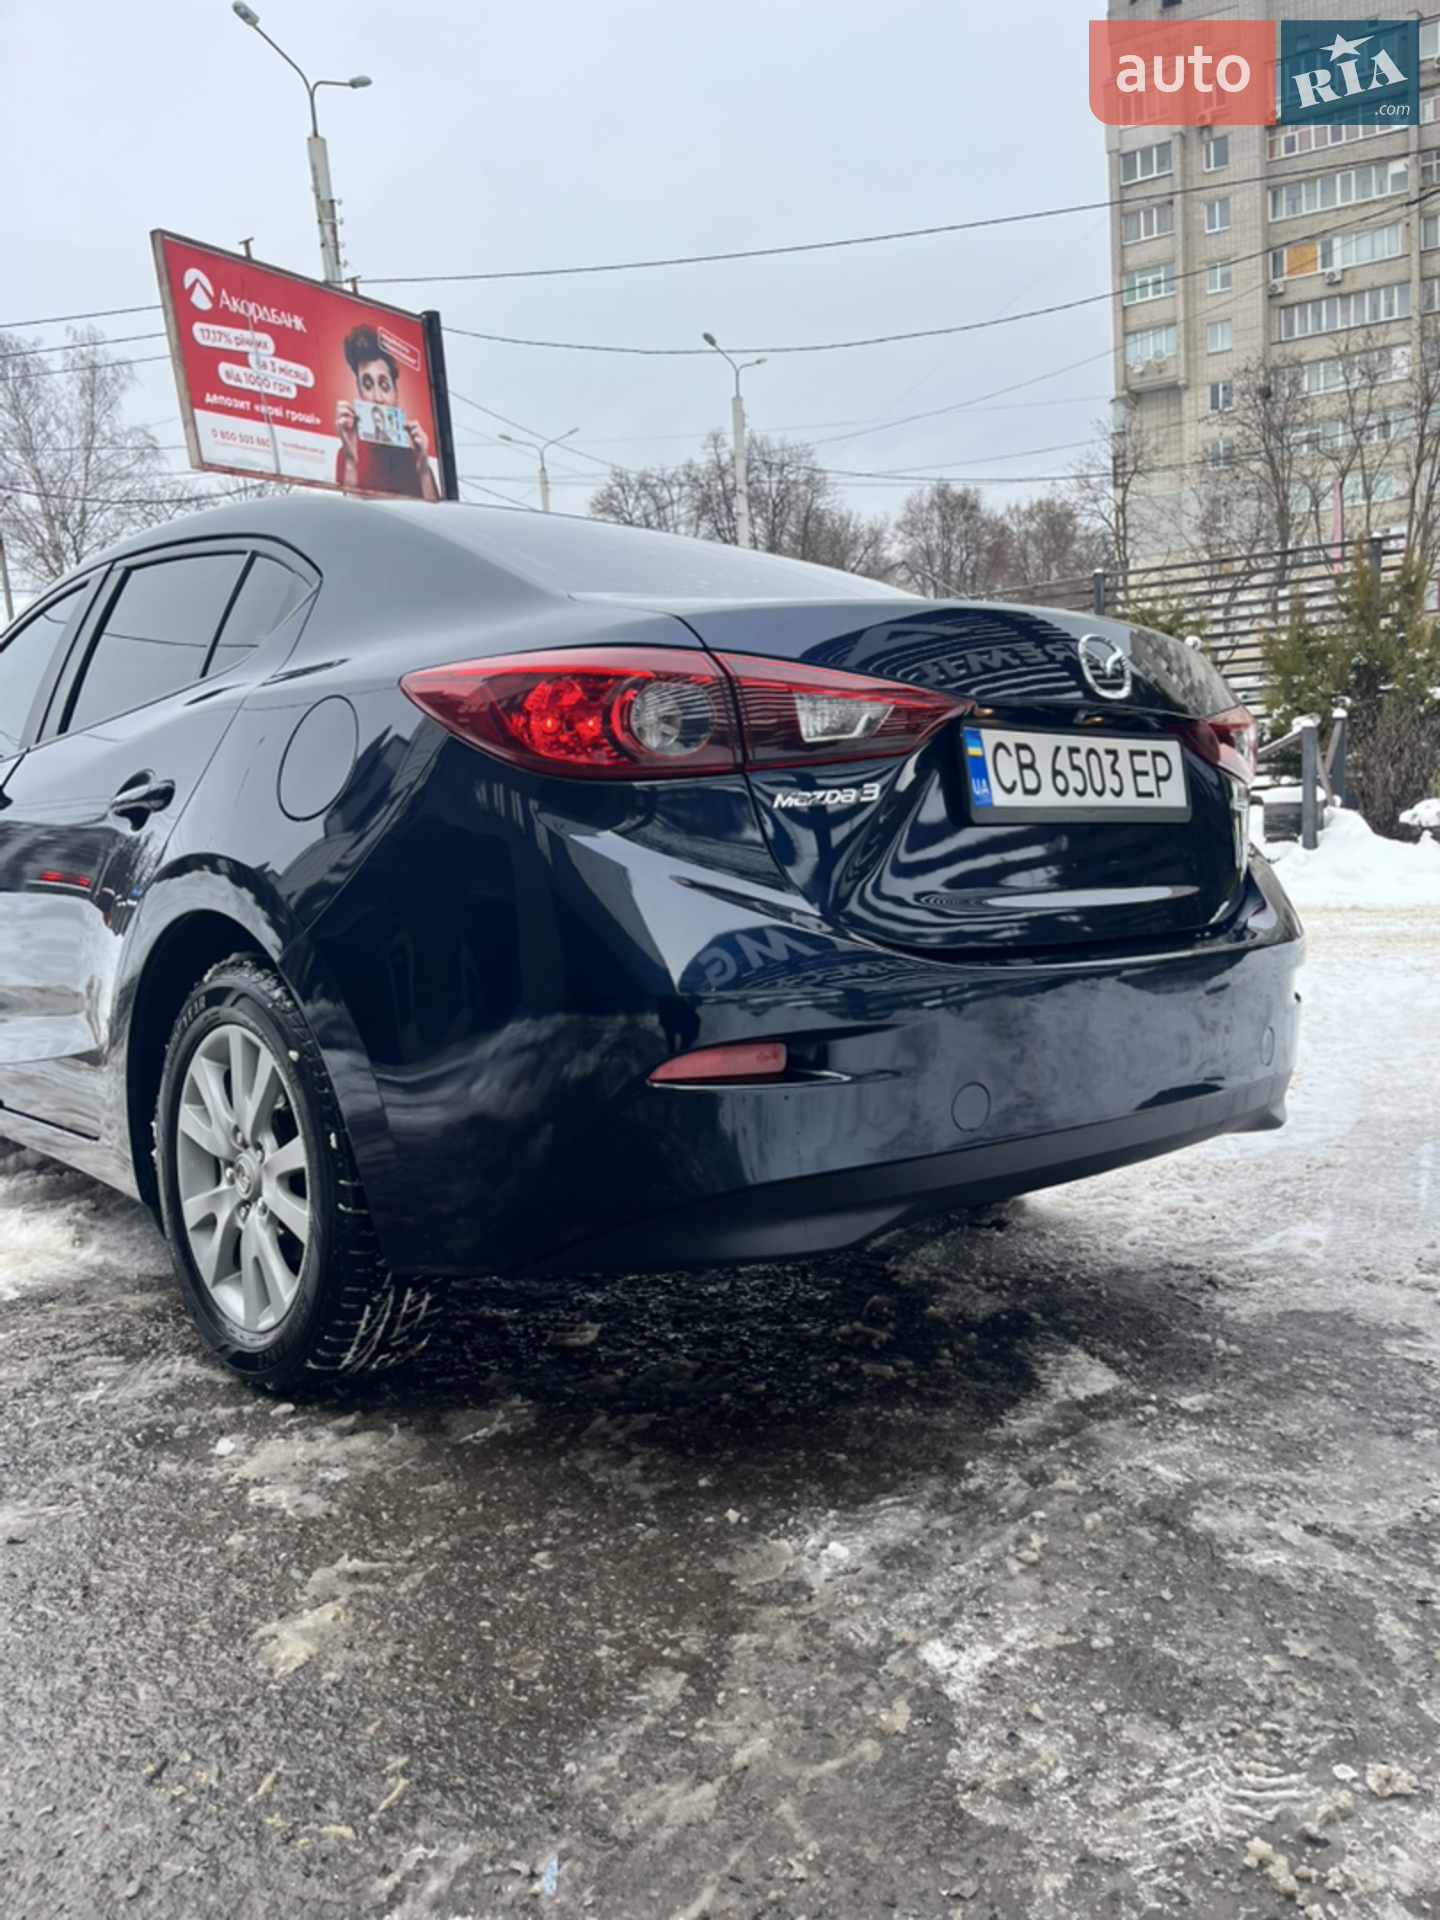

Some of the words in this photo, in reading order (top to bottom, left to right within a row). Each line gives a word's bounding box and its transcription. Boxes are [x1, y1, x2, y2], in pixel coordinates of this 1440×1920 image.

[243, 372, 271, 389] 1000
[992, 740, 1042, 796] CB
[1051, 745, 1125, 799] 6503
[1128, 749, 1173, 799] EP
[971, 777, 990, 796] UA
